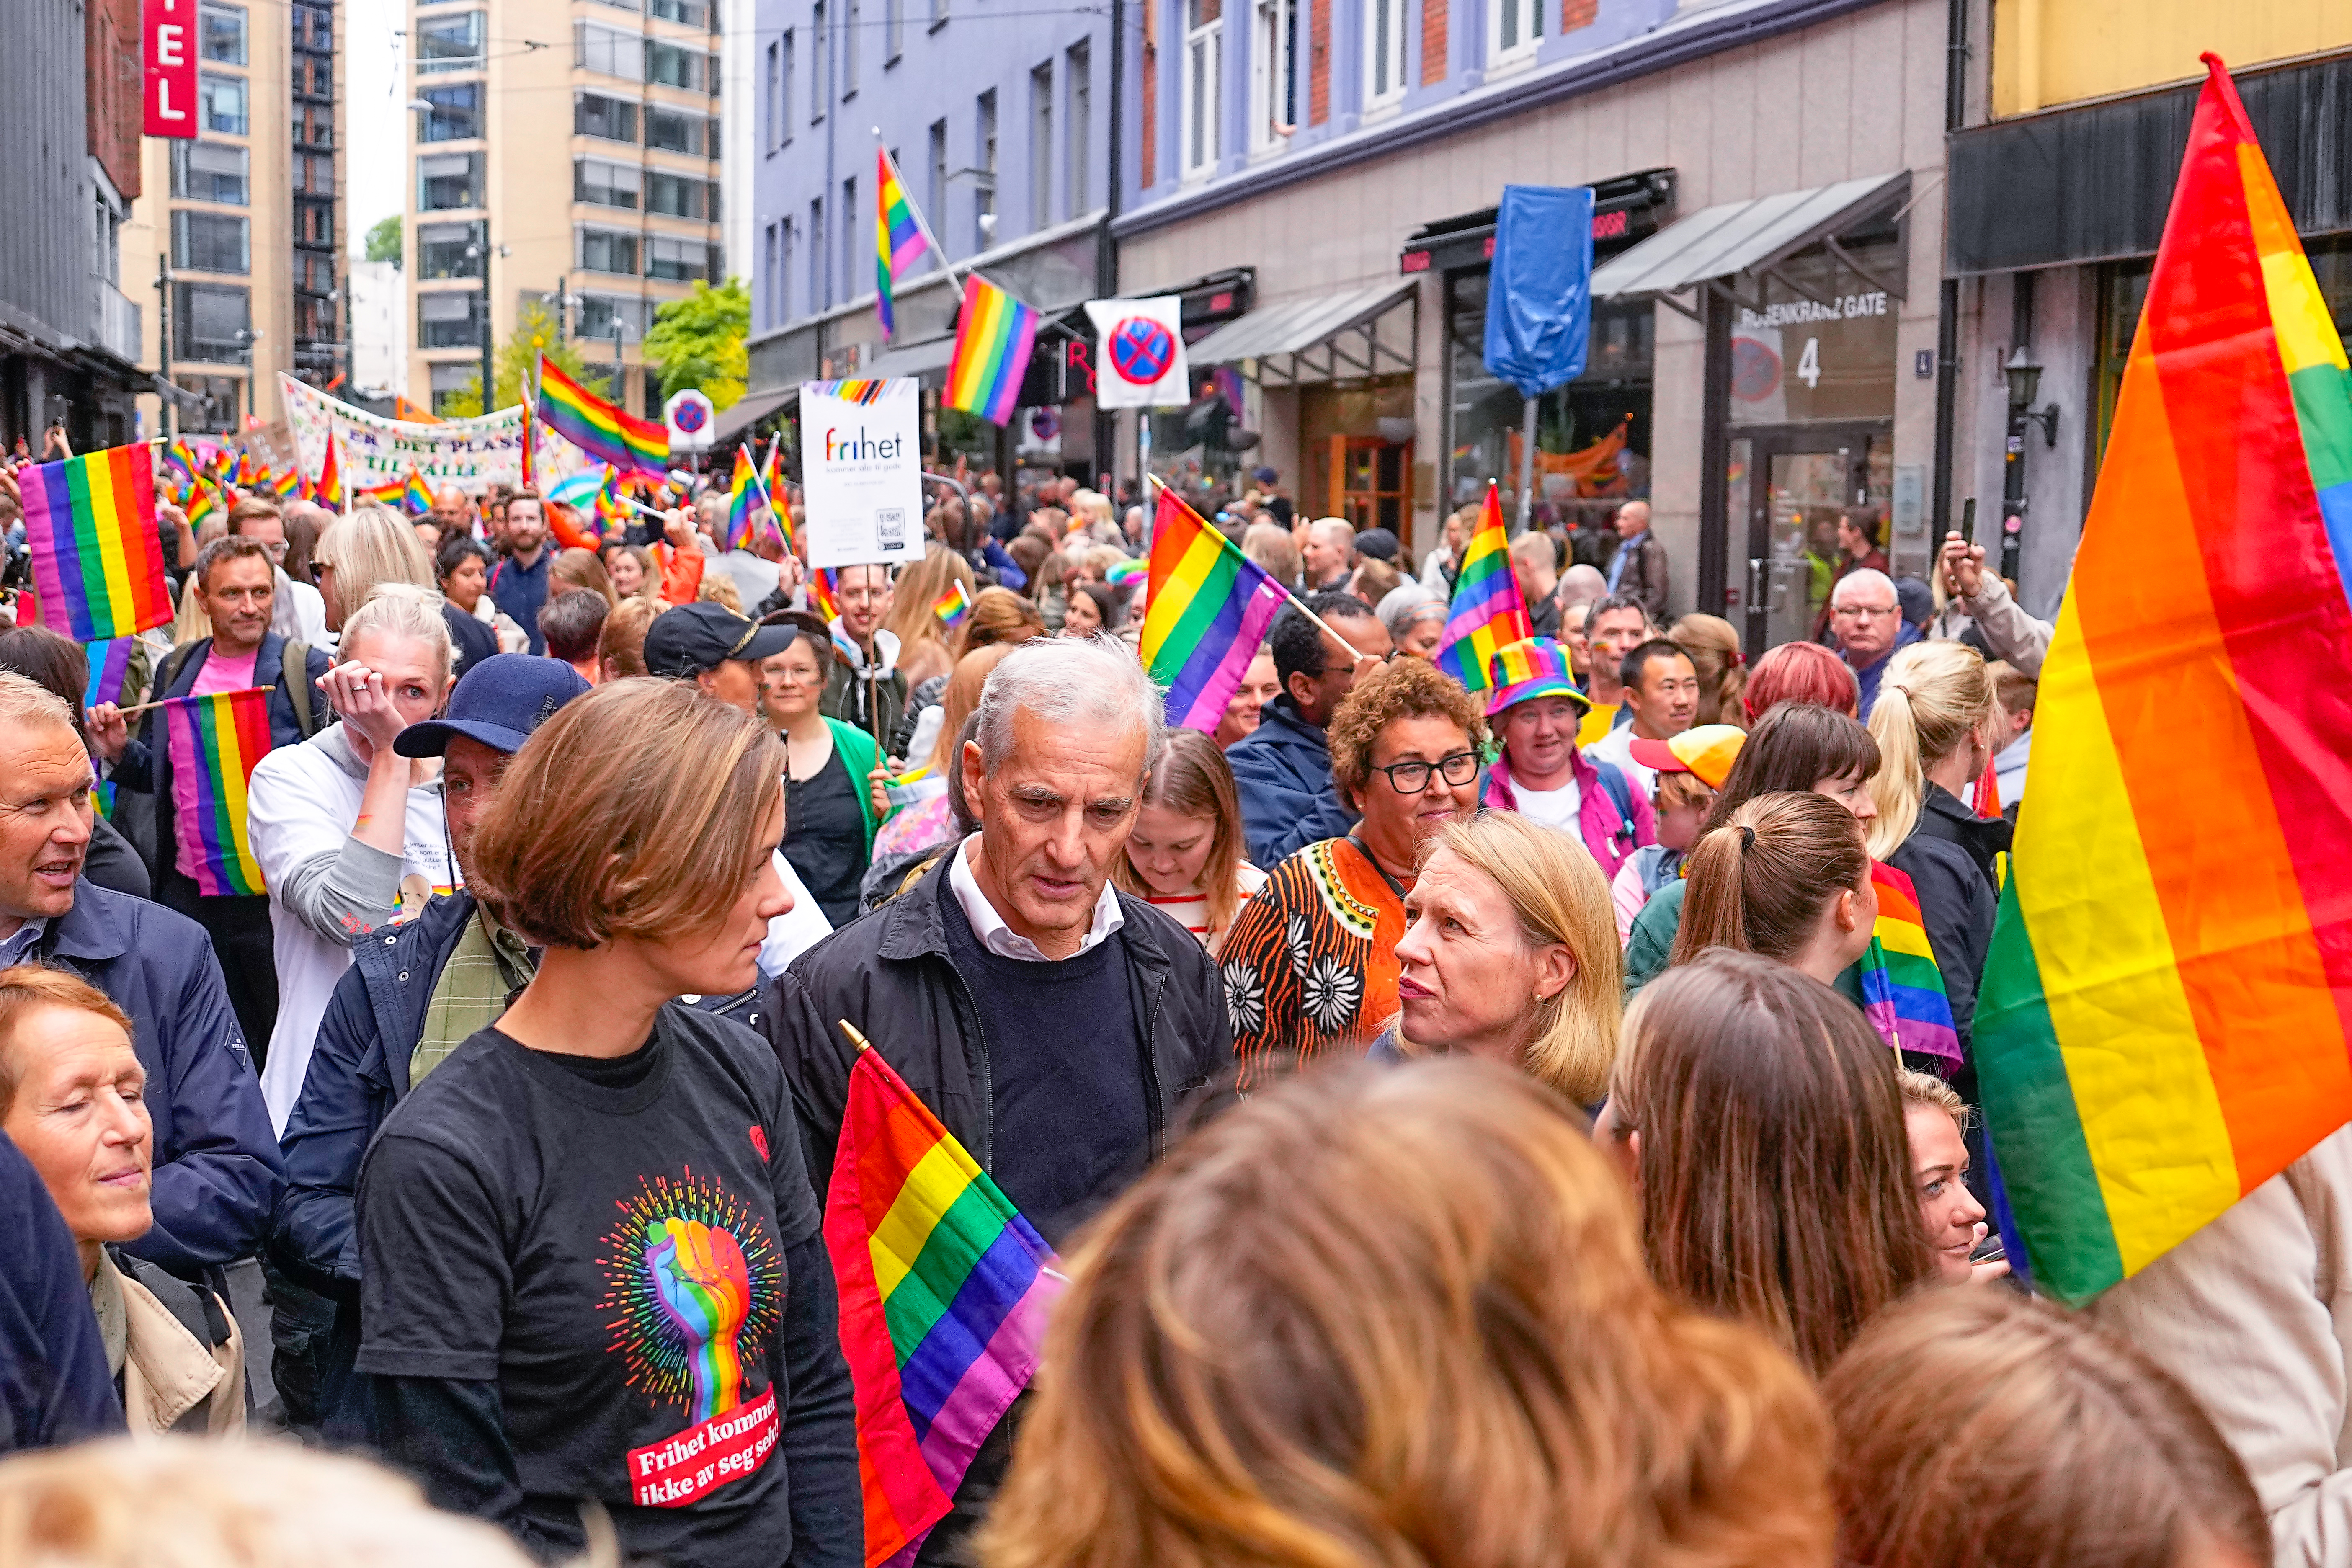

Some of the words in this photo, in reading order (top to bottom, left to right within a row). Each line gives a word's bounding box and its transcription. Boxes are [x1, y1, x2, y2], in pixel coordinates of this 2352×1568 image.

[157, 0, 186, 120] EL
[1844, 291, 1887, 318] GATE
[1797, 337, 1821, 389] 4
[395, 439, 438, 453] DET
[451, 436, 523, 453] PLASS
[826, 426, 902, 461] frihet
[365, 455, 400, 473] TIL
[859, 463, 872, 471] alle
[884, 462, 901, 472] gode
[638, 1431, 707, 1476] Frihet
[640, 1477, 694, 1506] ikke
[697, 1463, 715, 1488] av
[718, 1444, 754, 1475] seg
[755, 1418, 779, 1458] selv!
